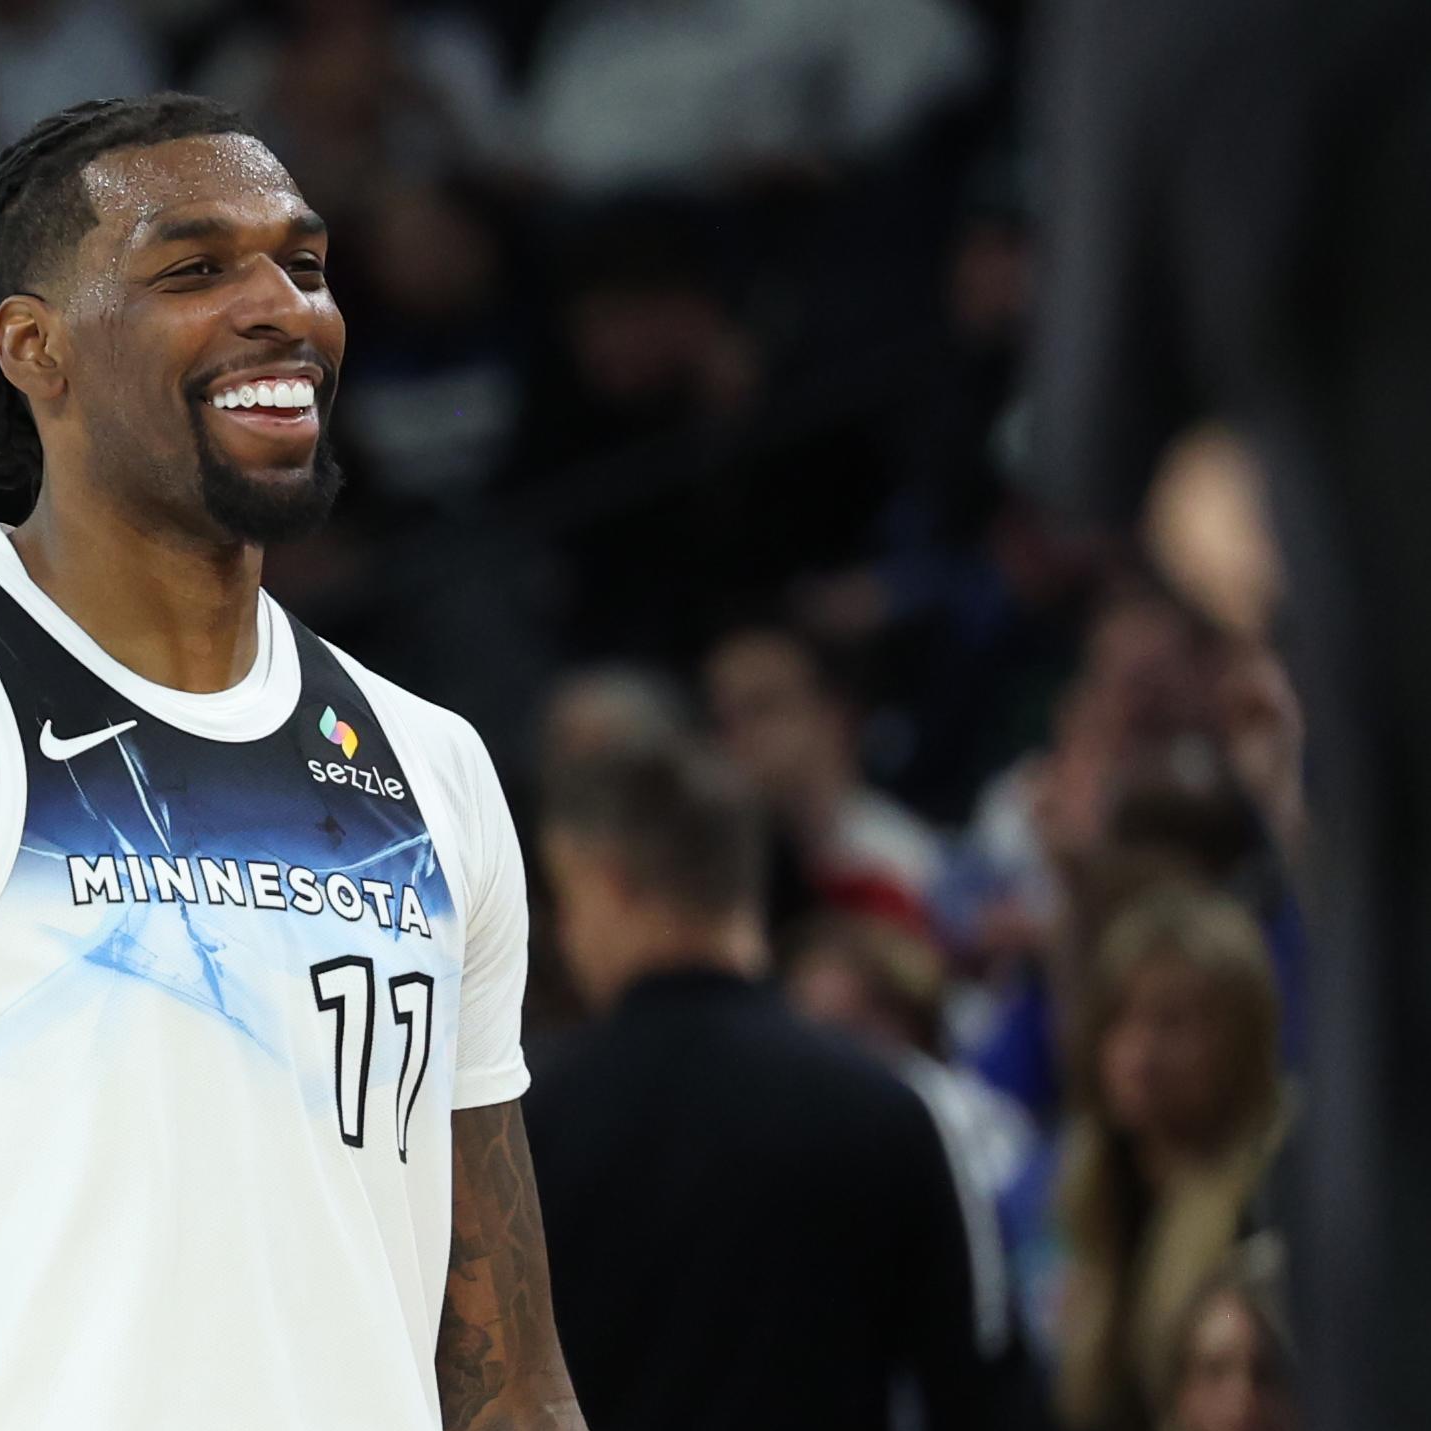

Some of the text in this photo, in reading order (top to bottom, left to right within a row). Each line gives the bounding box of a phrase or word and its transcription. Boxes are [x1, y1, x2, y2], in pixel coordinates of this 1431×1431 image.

[307, 759, 405, 800] sezzle
[67, 855, 432, 938] MINNESOTA
[310, 954, 434, 1164] 11
